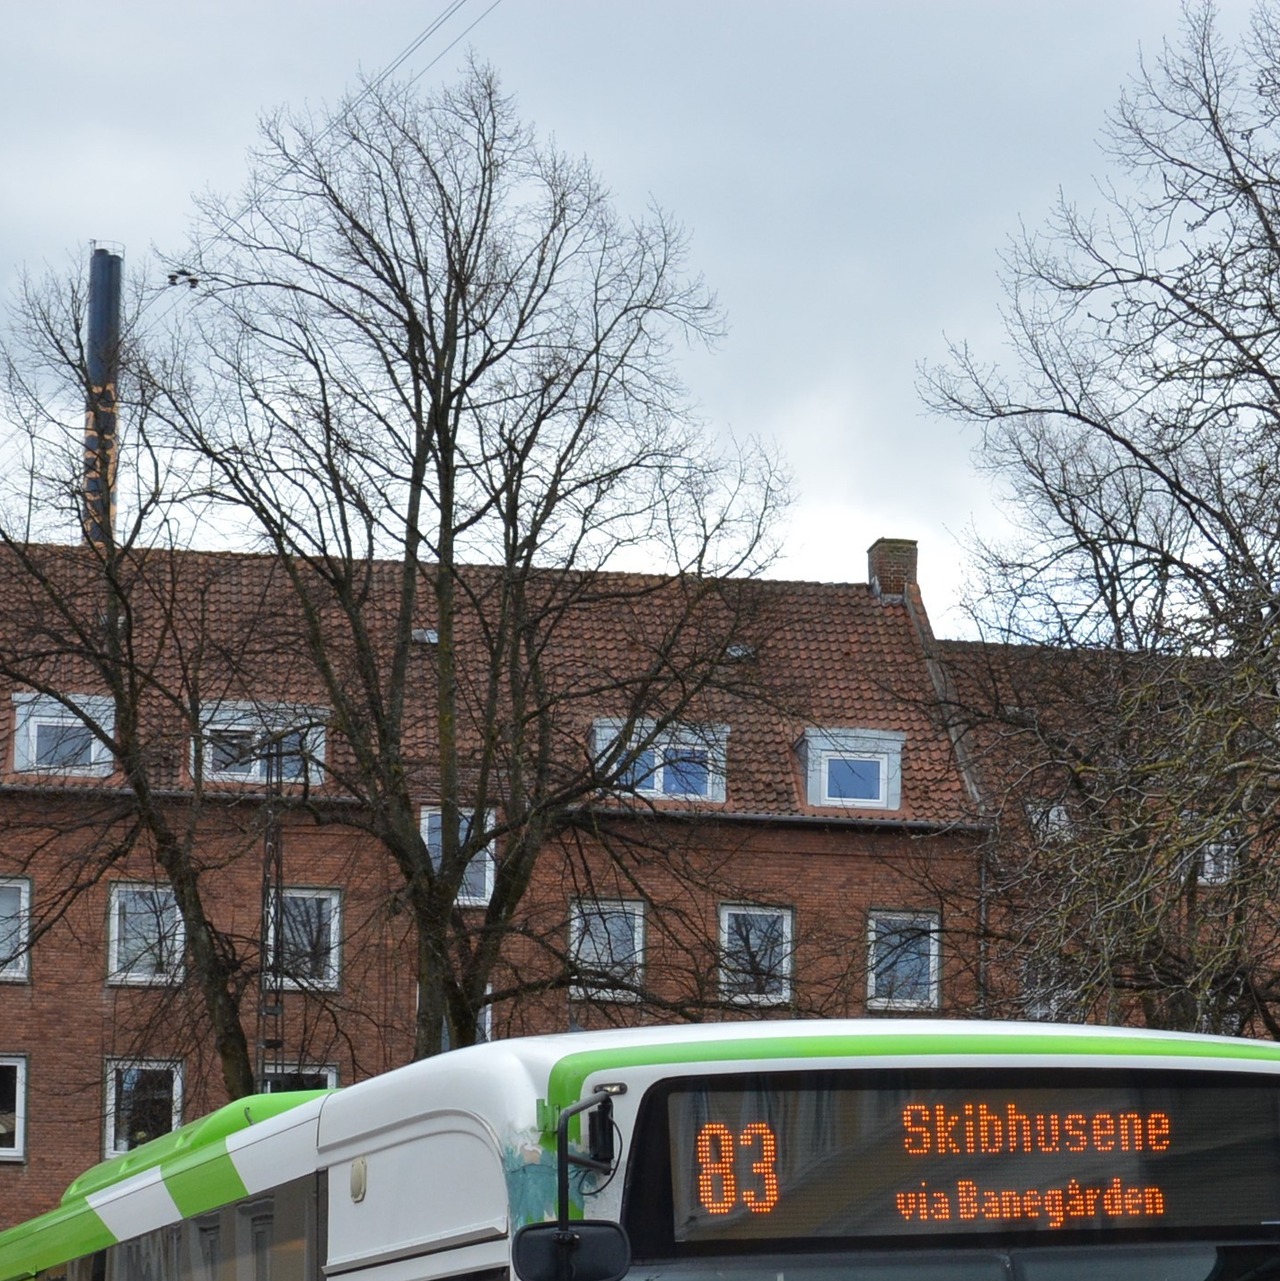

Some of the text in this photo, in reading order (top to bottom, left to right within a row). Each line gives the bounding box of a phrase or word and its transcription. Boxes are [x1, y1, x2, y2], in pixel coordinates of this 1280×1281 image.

[902, 1104, 1171, 1154] Skibhusene
[697, 1122, 780, 1214] 83
[896, 1177, 1165, 1228] via Banegården
